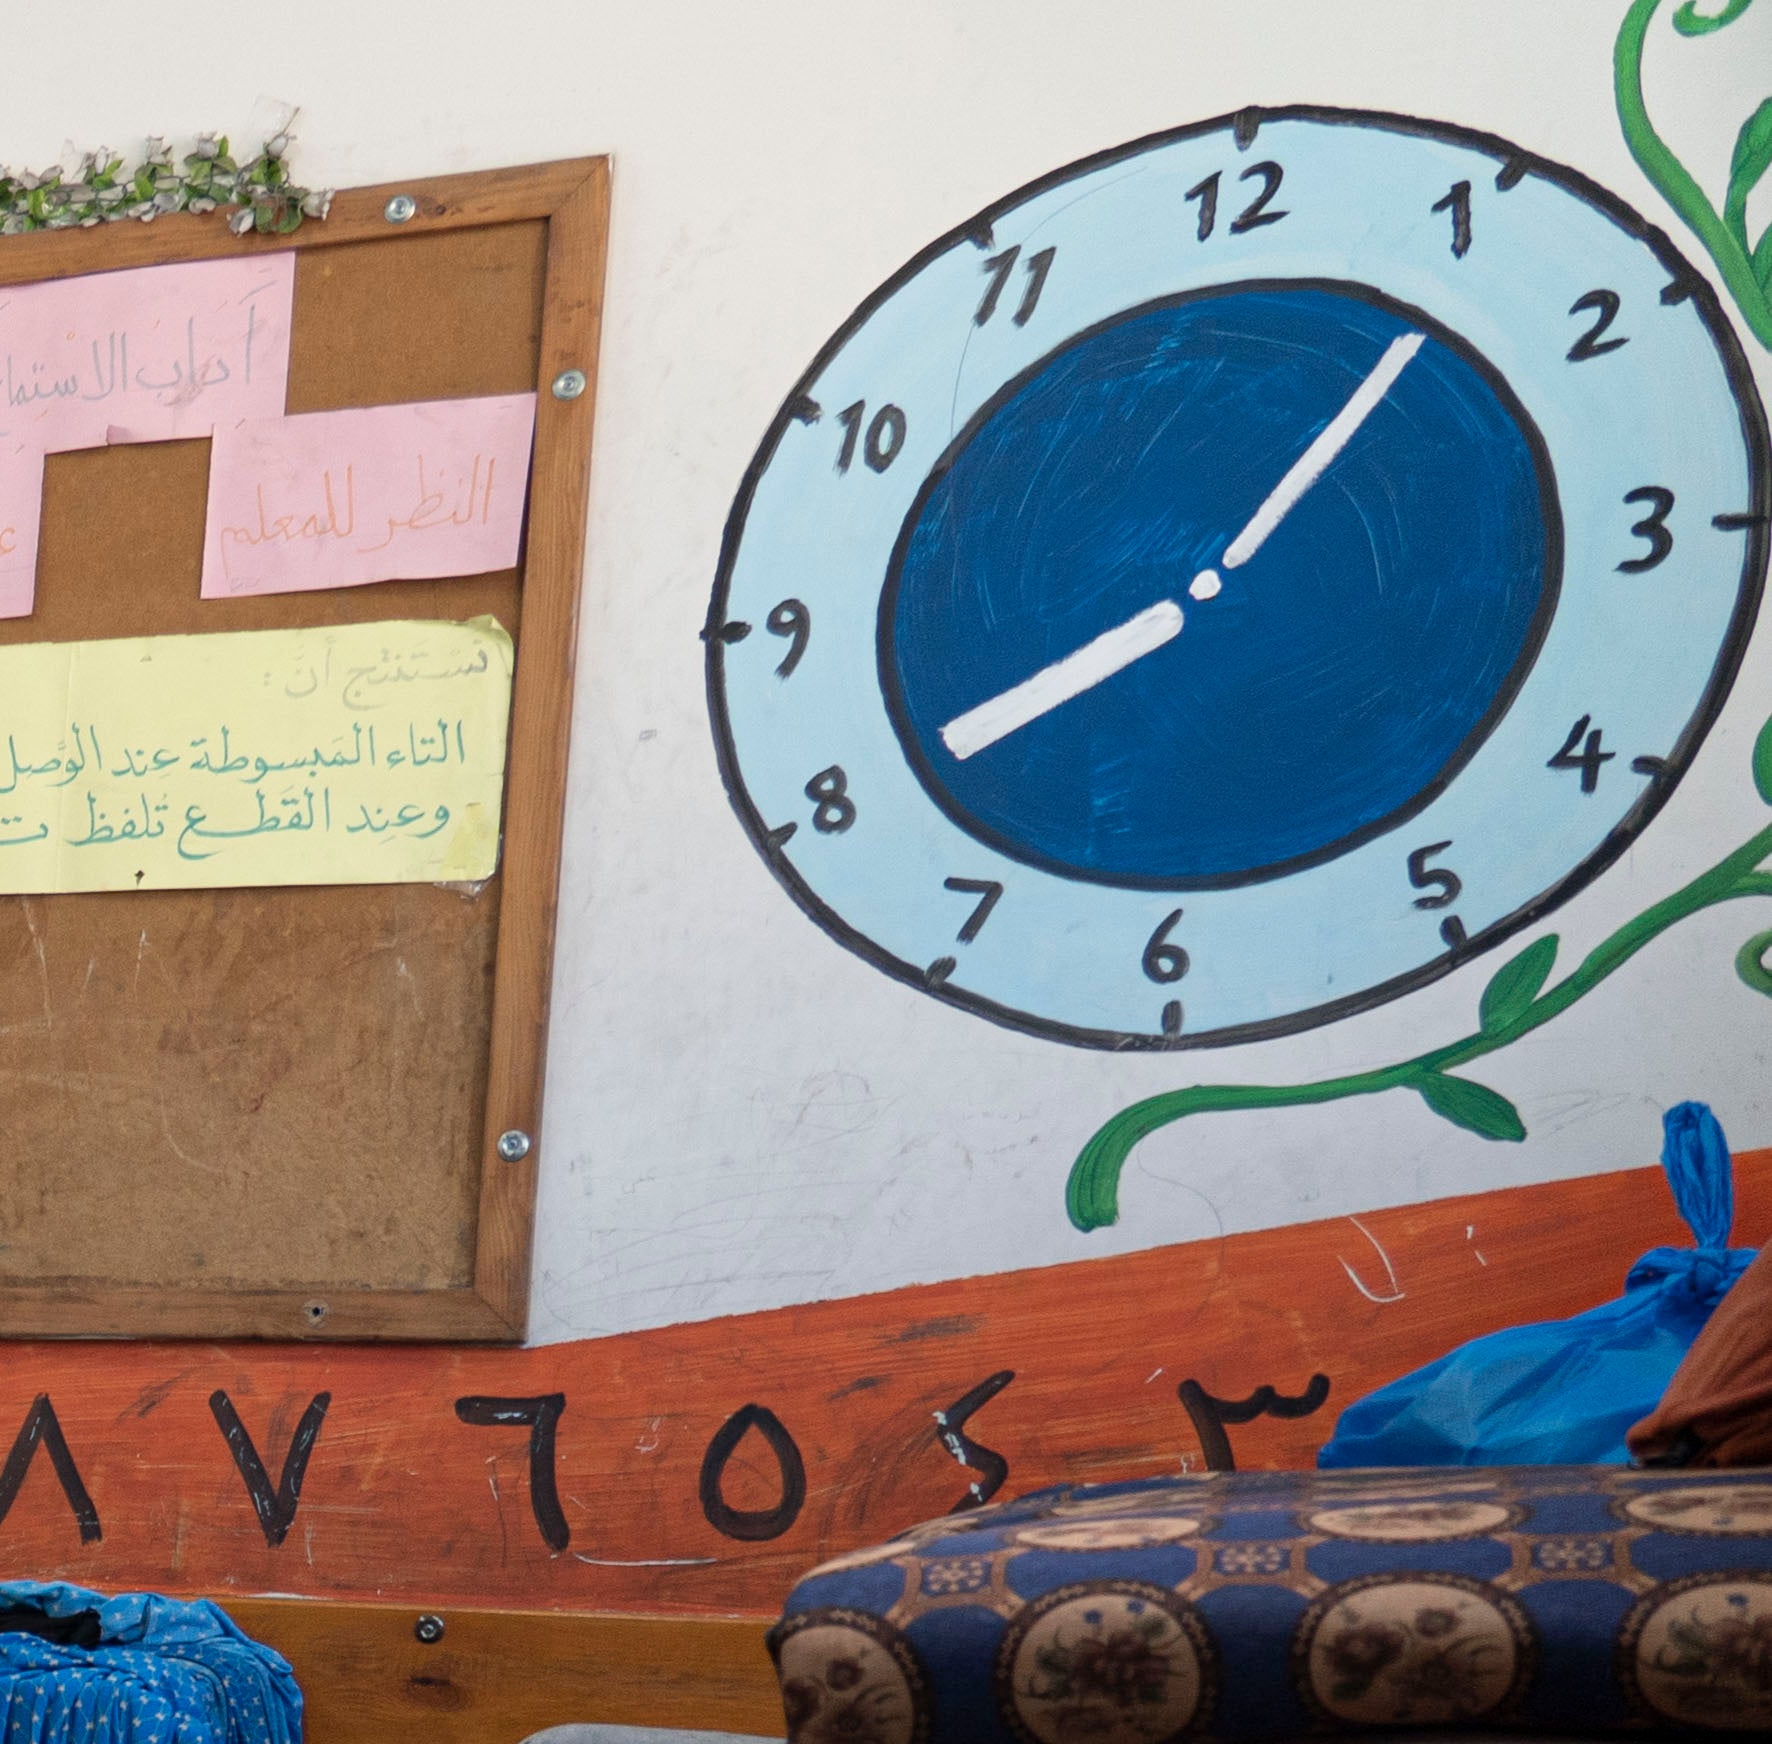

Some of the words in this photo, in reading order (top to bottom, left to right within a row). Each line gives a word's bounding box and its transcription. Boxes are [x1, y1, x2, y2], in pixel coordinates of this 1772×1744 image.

[1186, 162, 1288, 240] 12
[1432, 178, 1472, 259] 1
[972, 243, 1058, 328] 11
[1566, 289, 1629, 361] 2
[834, 400, 907, 477] 10
[1616, 486, 1675, 573] 3
[767, 598, 811, 680] 9
[1547, 714, 1615, 794] 4
[804, 765, 855, 836] 8
[943, 876, 1003, 945] 7
[1407, 842, 1460, 909] 5
[1142, 908, 1190, 984] 6
